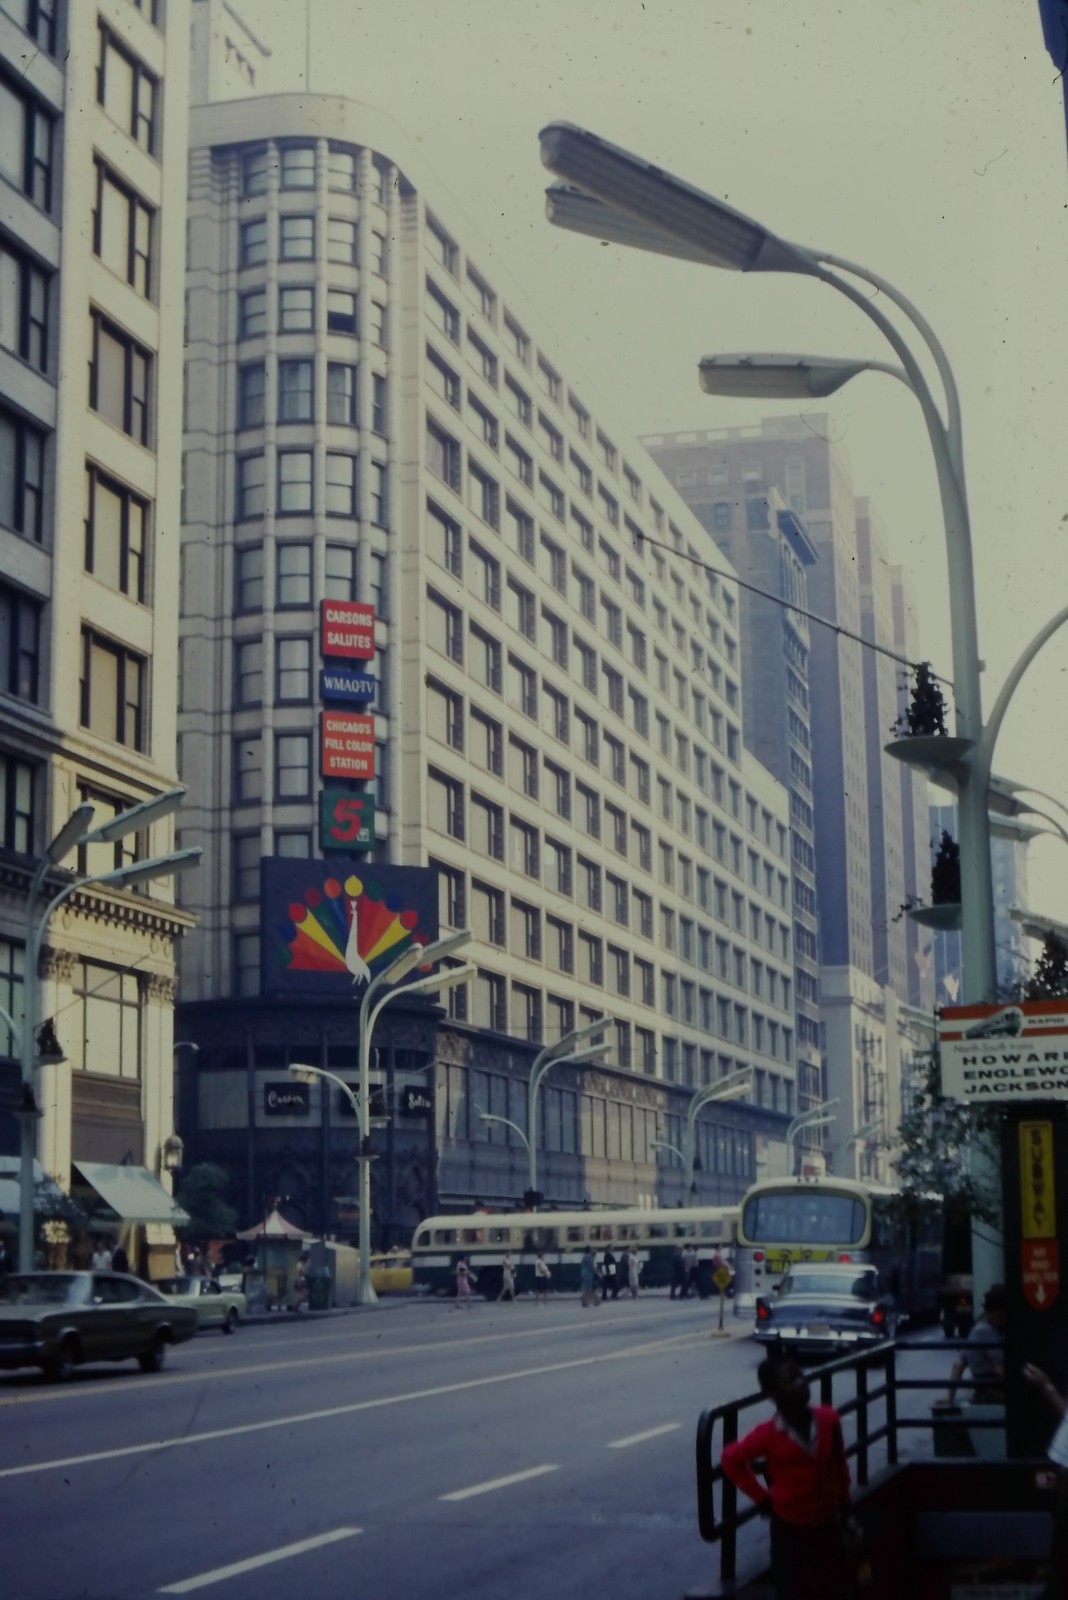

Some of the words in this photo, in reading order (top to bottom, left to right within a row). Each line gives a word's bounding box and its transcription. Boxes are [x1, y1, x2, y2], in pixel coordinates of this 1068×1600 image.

[326, 609, 373, 628] CARSONS
[327, 631, 371, 649] SALUTES
[326, 719, 371, 735] CHICAGO'S
[325, 737, 345, 750] FULL
[346, 740, 373, 753] COLOR
[330, 756, 368, 771] STATION
[329, 798, 365, 842] 5
[964, 1081, 1068, 1094] JACKSON
